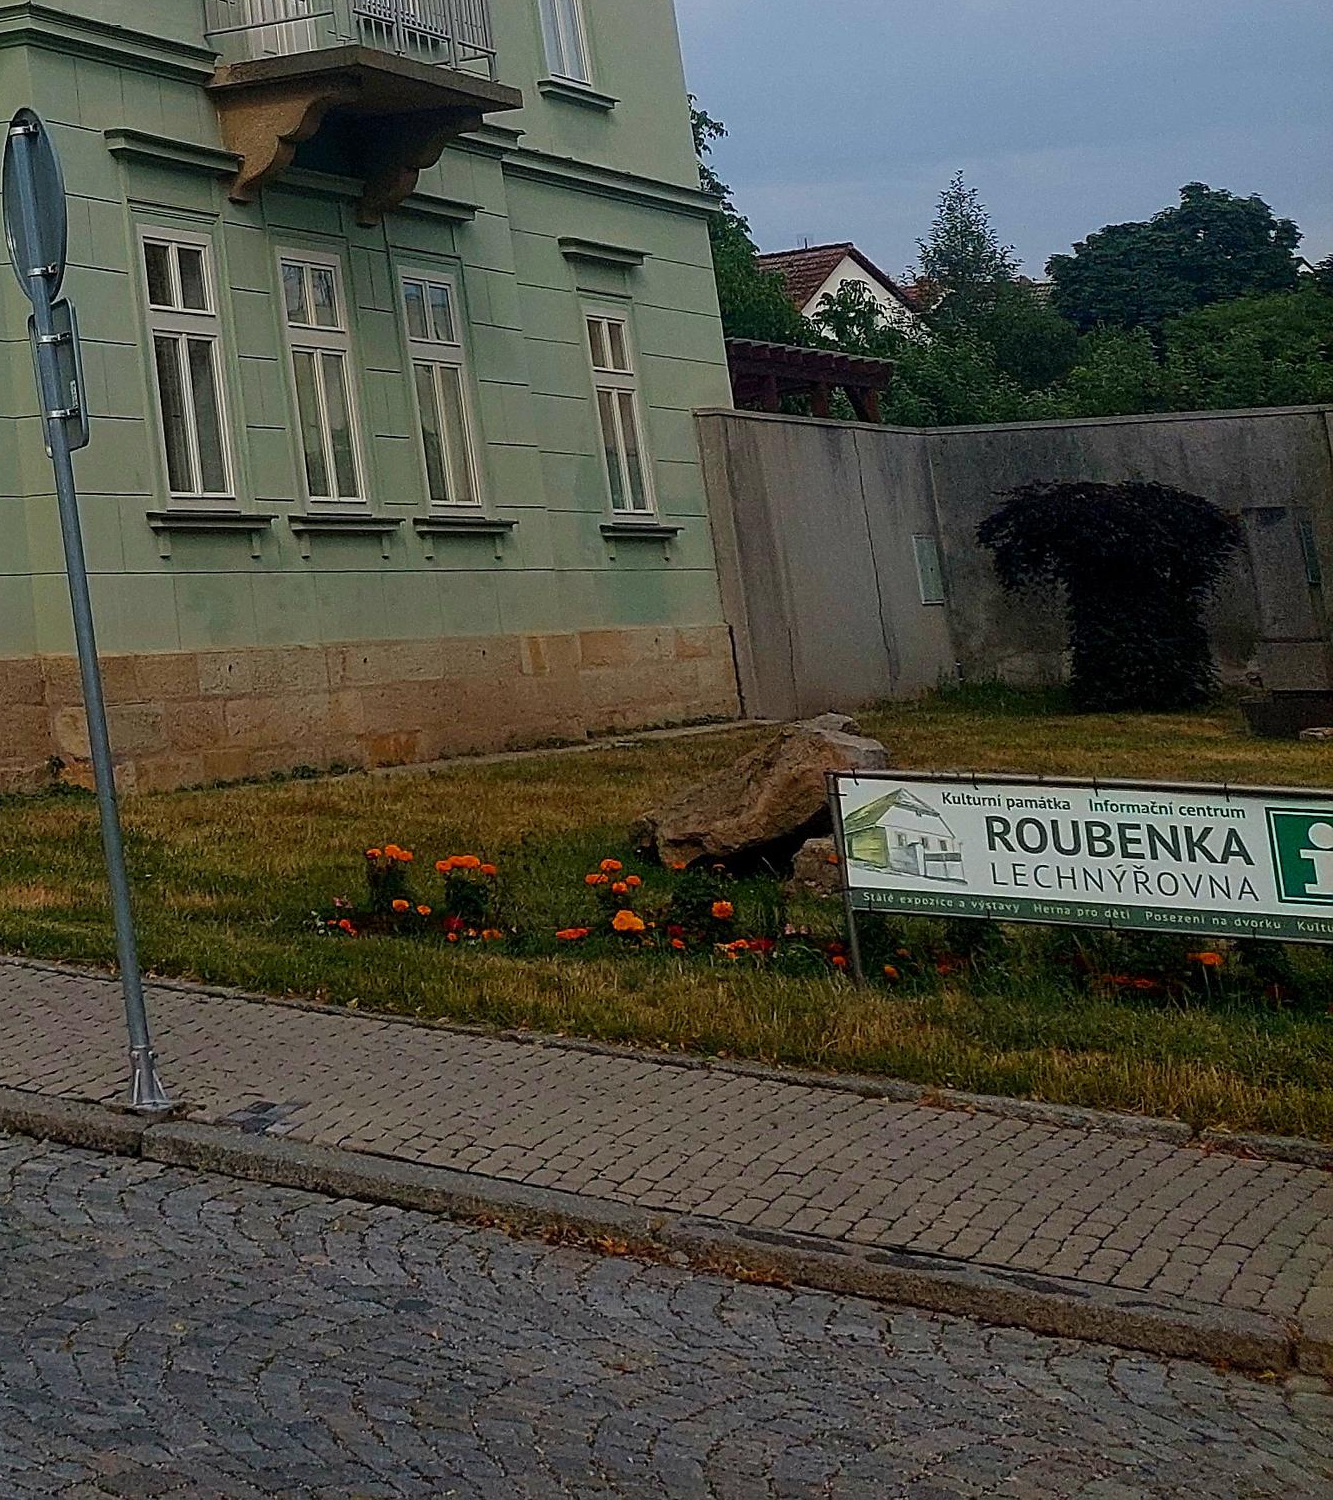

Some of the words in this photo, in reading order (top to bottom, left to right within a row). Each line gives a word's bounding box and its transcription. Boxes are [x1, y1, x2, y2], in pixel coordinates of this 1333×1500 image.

[941, 791, 1002, 807] Kulturní
[1006, 795, 1071, 811] památka
[1088, 798, 1174, 816] Informační
[1178, 805, 1246, 819] centrum
[985, 815, 1256, 866] ROUBENKA
[990, 861, 1260, 902] LECHNÝŘOVNA
[863, 891, 895, 904] Stálé
[899, 896, 954, 908] expozice
[958, 899, 966, 908] a
[971, 899, 1021, 914] výstavy
[1033, 903, 1071, 915] Herna
[1077, 908, 1099, 917] pro
[1212, 916, 1228, 926] na
[1234, 918, 1281, 930] dvorku
